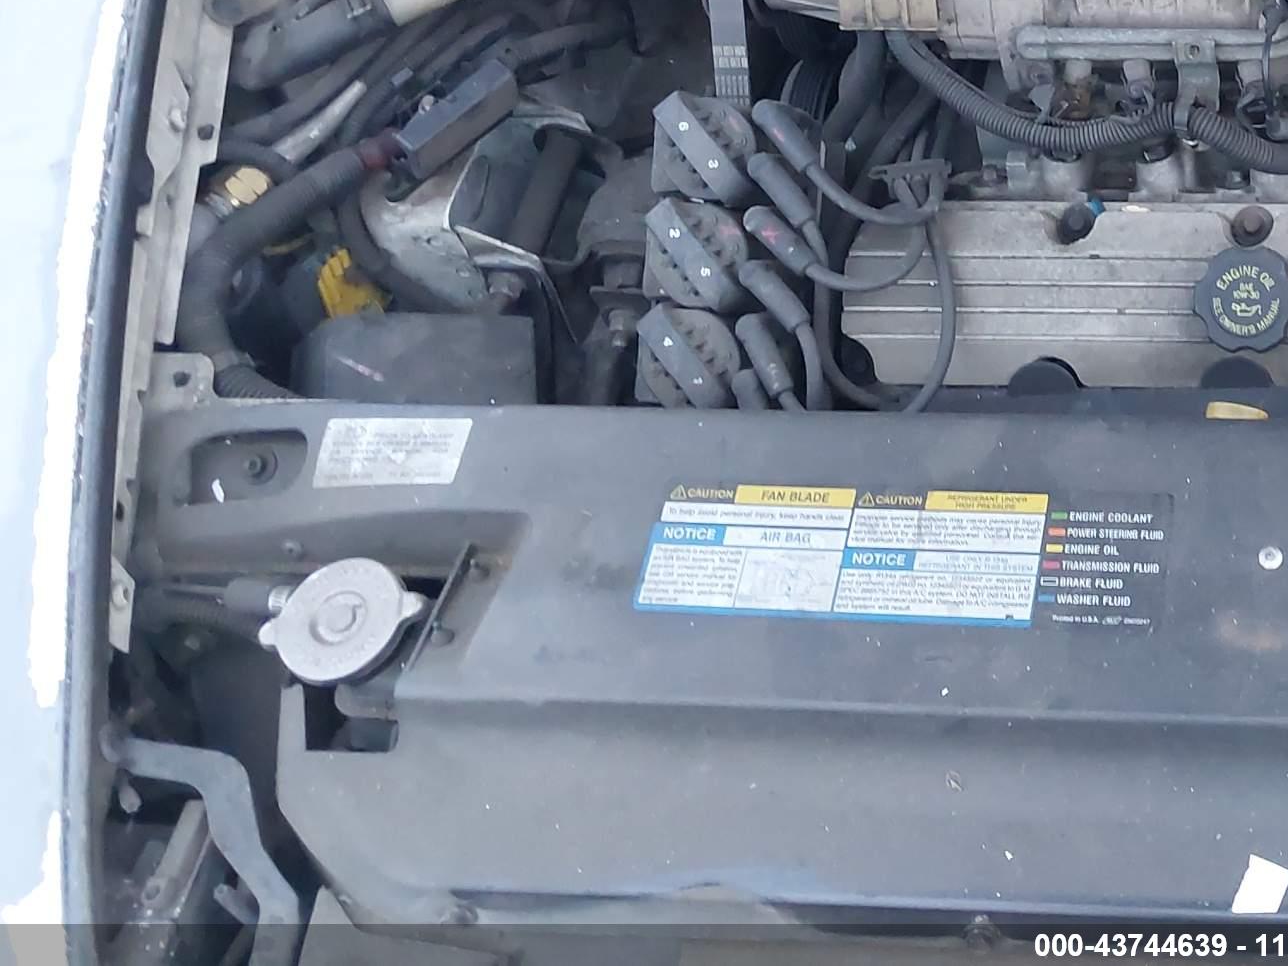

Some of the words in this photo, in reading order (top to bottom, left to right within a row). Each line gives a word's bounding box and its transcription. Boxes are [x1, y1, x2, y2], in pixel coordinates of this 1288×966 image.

[669, 228, 681, 238] 2
[700, 266, 711, 277] 5
[1216, 265, 1260, 290] ENGINE
[663, 336, 674, 347] 4
[687, 487, 734, 499] CAUTION
[760, 489, 788, 502] FAN
[788, 491, 830, 504] BLADE
[875, 494, 923, 506] CAUTION
[1069, 511, 1104, 522] ENGINE
[1107, 512, 1154, 524] COOLANT
[663, 526, 716, 541] NOTICE
[760, 530, 783, 543] AIR
[784, 531, 812, 544] BAG
[1067, 527, 1097, 539] POWER
[1099, 528, 1138, 540] STEERING
[1140, 529, 1165, 540] FLUID
[1064, 543, 1100, 555] ENGINE
[1103, 544, 1120, 556] OIL
[852, 552, 907, 566] NOTICE
[1061, 560, 1131, 573] TRANSMISSION
[1133, 562, 1160, 574] FLUID
[1060, 576, 1092, 588] BRAKE
[1094, 578, 1124, 589] FLUID
[1056, 593, 1100, 606] WASHER
[1102, 595, 1132, 607] FLUID
